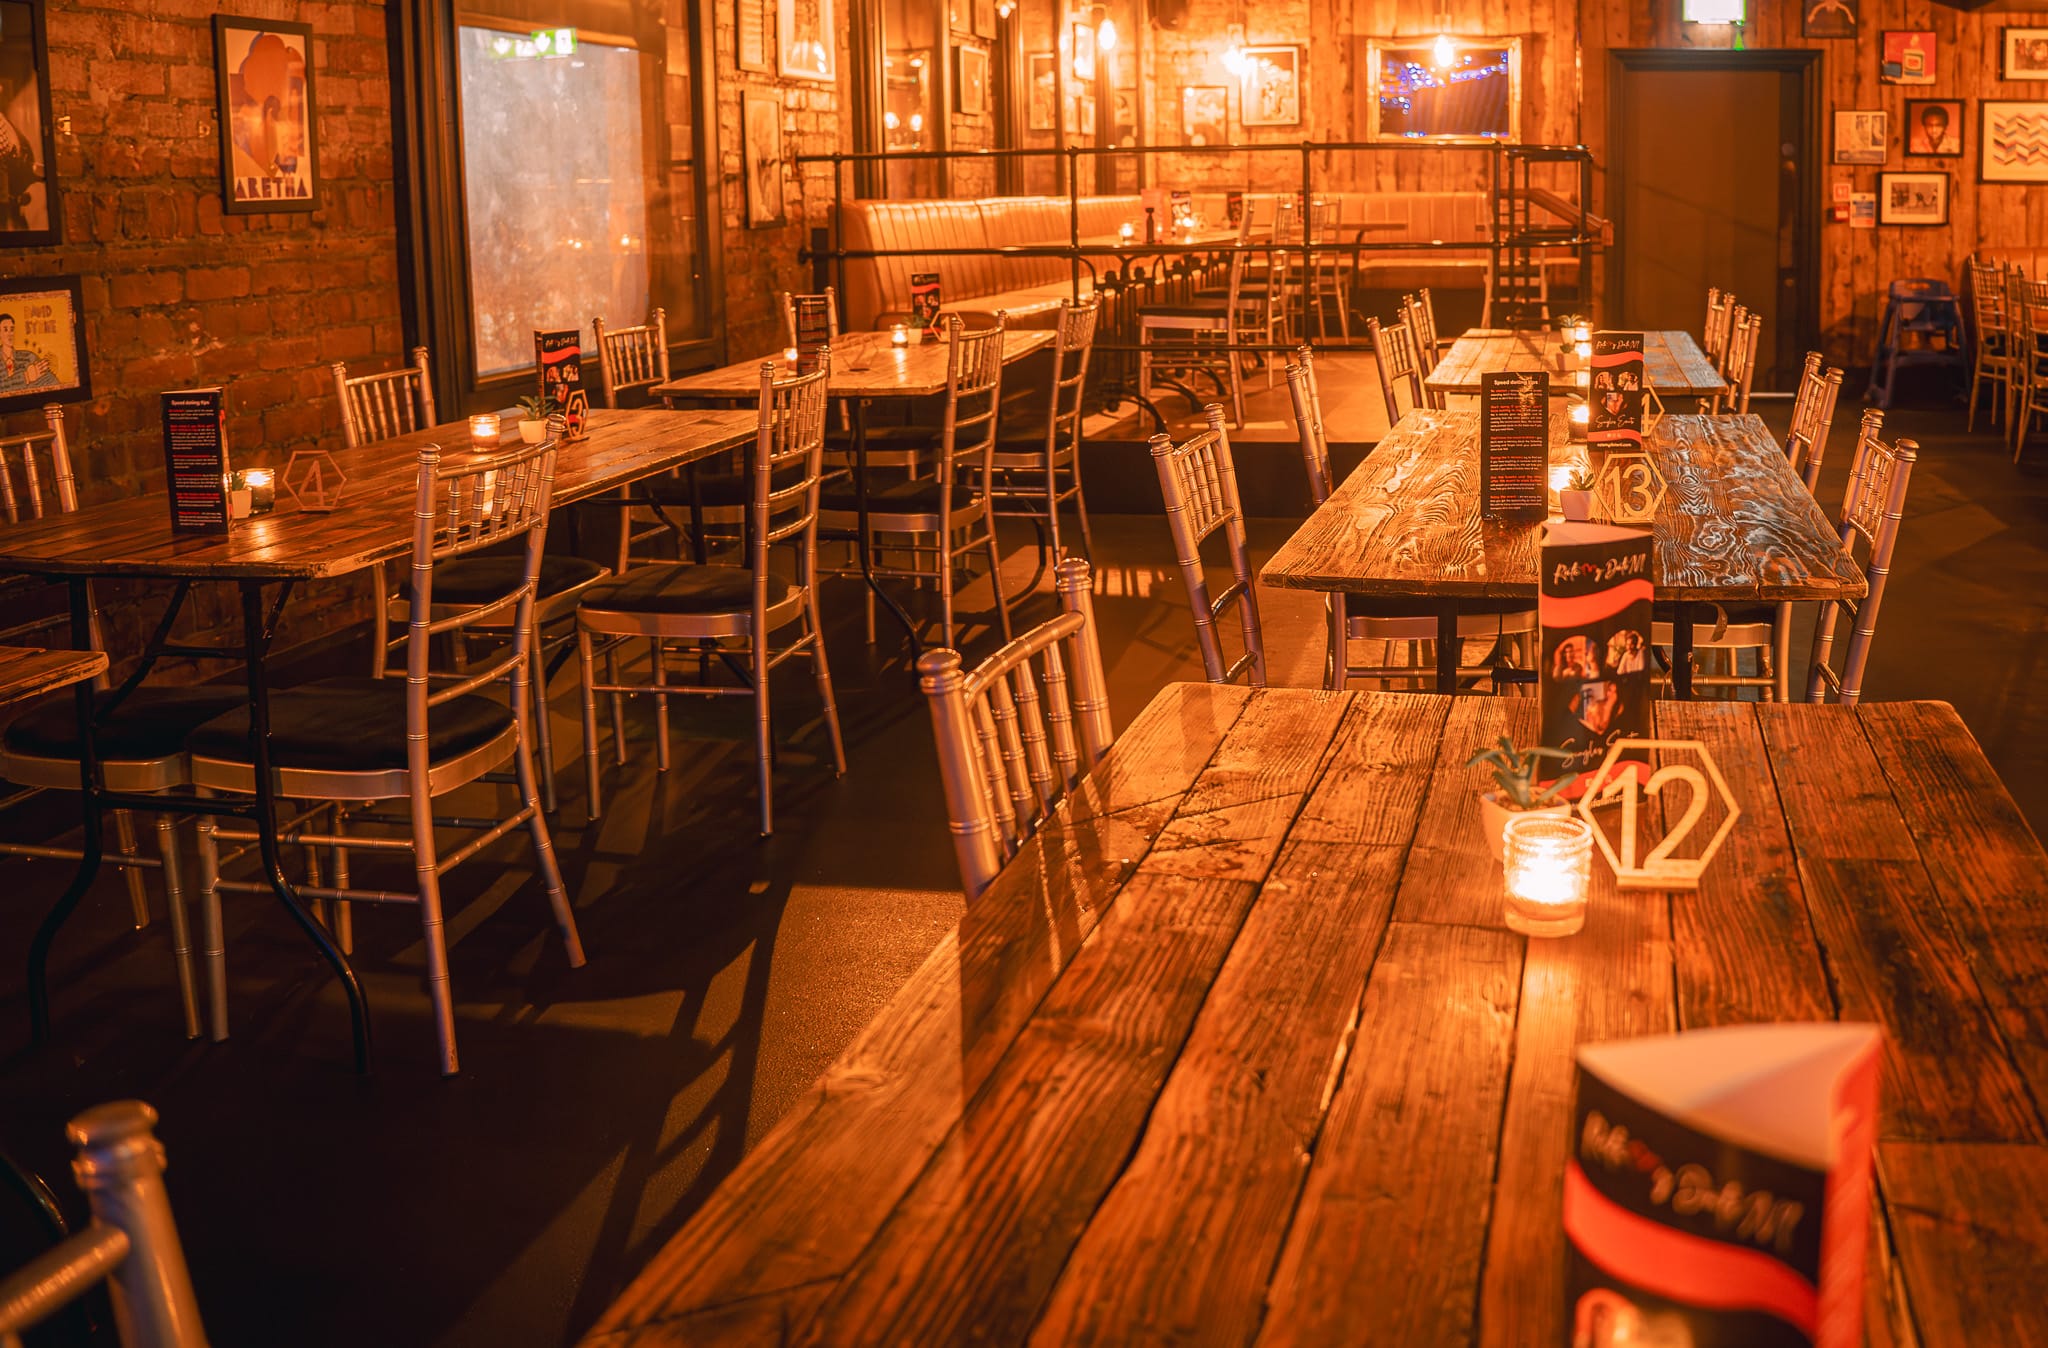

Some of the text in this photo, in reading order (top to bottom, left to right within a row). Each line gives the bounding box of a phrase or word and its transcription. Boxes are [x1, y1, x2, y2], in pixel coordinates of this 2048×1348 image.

[235, 176, 308, 199] ARETHA
[299, 459, 328, 506] 4
[1604, 463, 1654, 518] 13
[1602, 764, 1709, 876] 12
